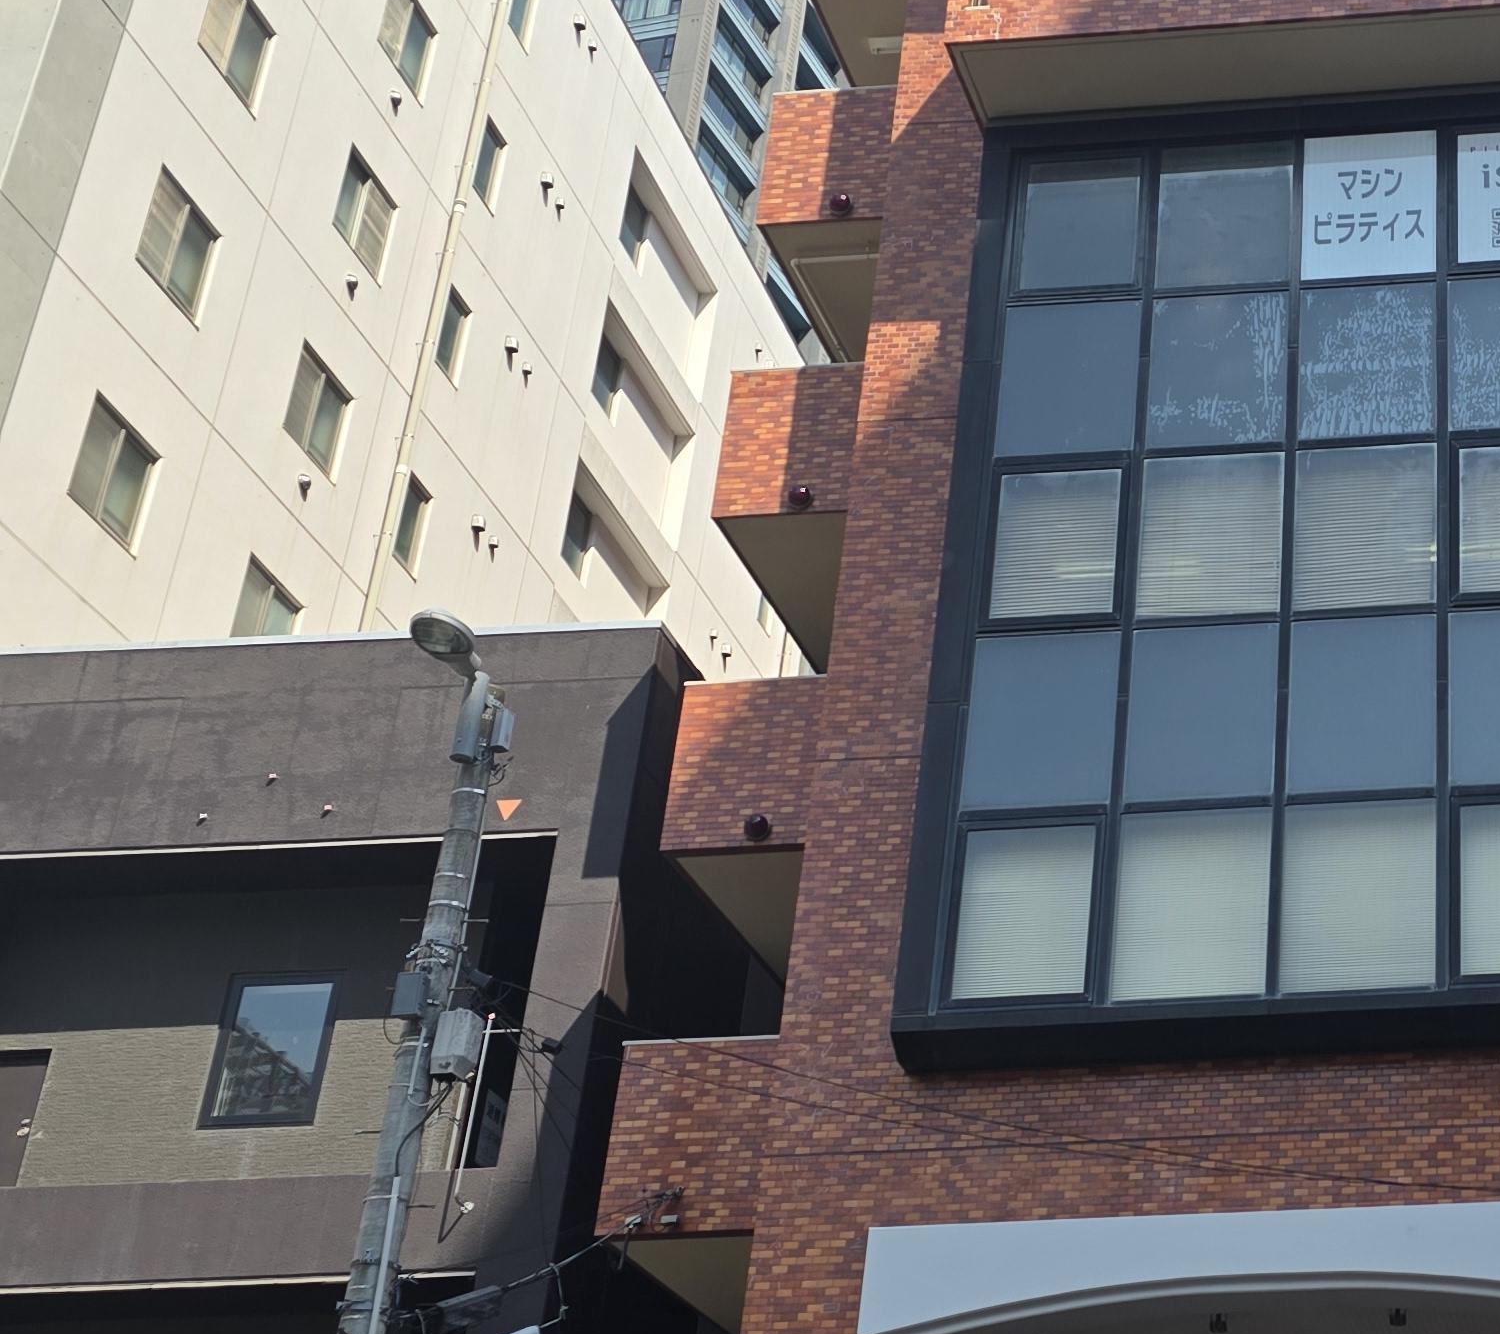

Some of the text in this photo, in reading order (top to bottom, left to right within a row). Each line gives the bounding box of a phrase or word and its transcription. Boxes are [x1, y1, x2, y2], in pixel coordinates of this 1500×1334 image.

[1337, 169, 1403, 200] マシン
[1314, 209, 1425, 245] ピラティス
